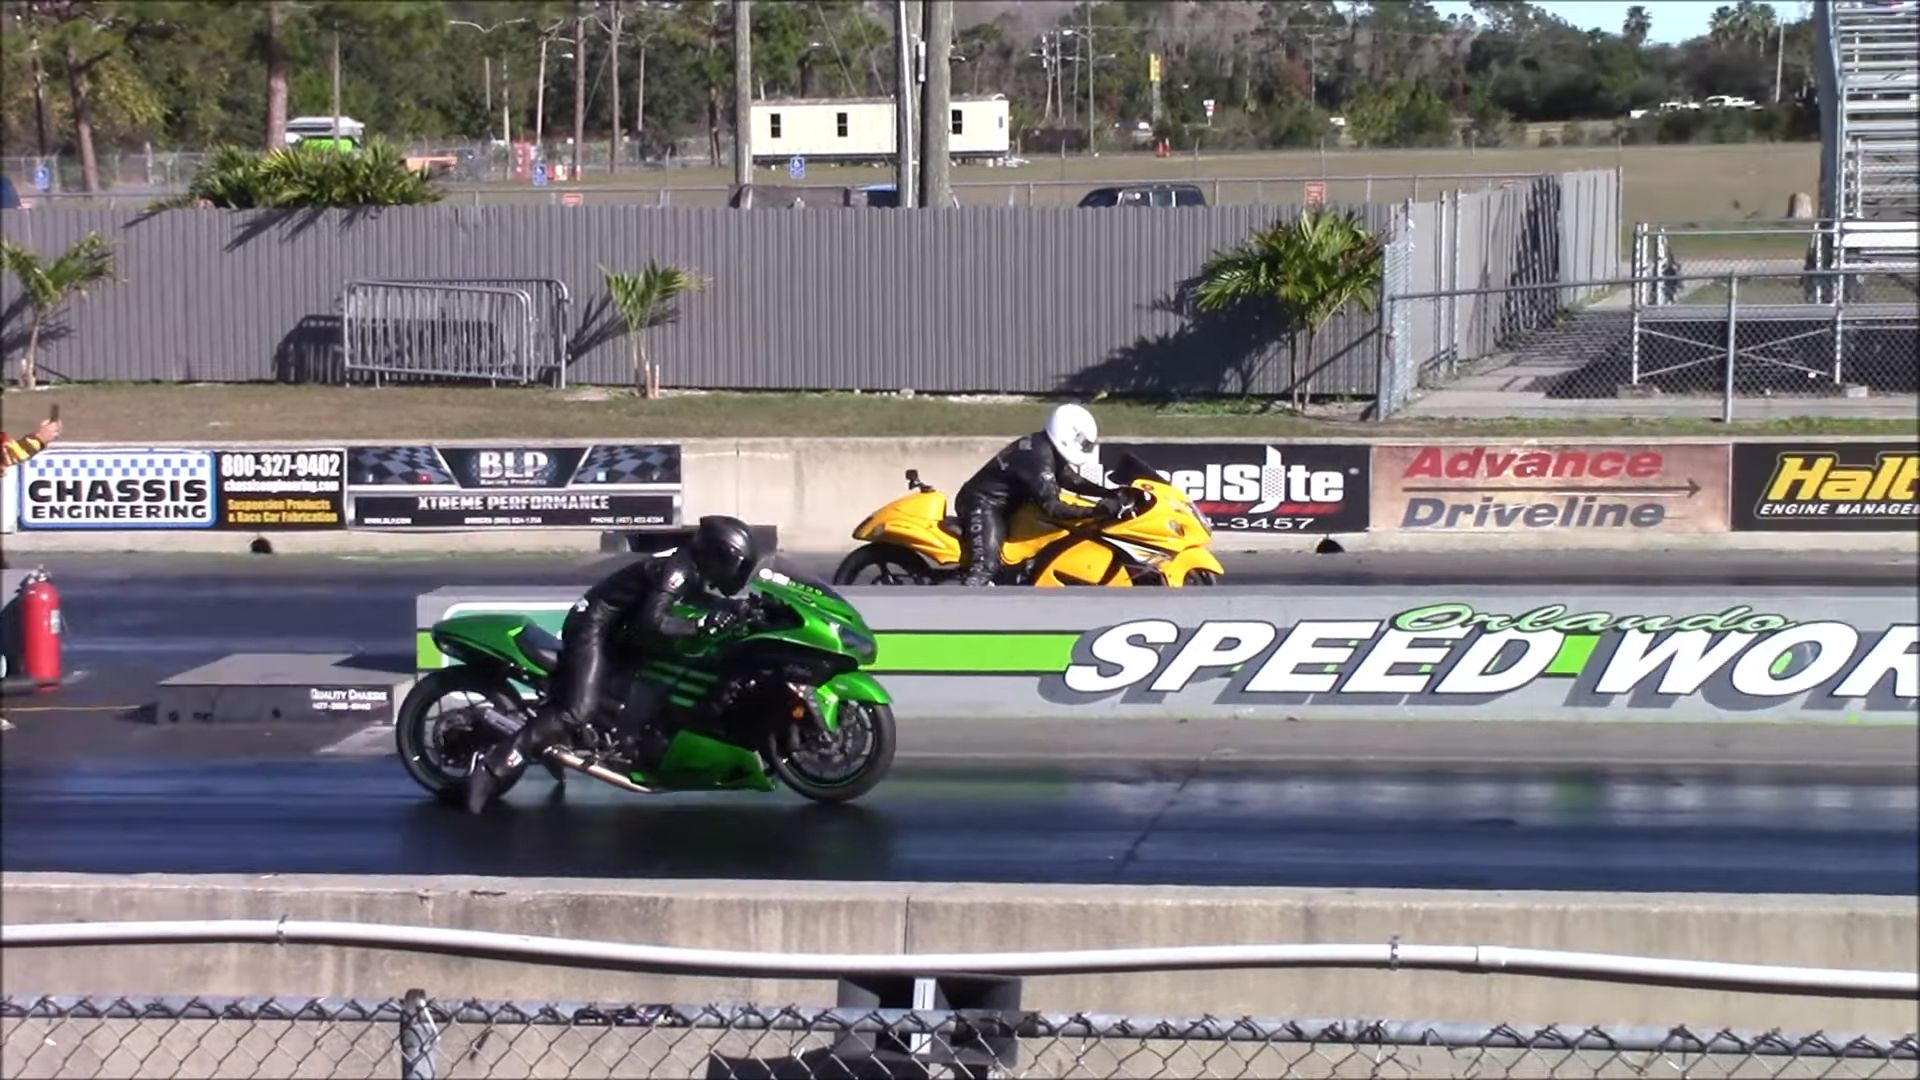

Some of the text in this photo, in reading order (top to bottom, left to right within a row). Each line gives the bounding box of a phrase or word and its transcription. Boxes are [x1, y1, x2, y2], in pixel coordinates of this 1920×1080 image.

[222, 454, 340, 477] 800-327-9402
[480, 451, 548, 478] BLP
[1402, 447, 1664, 479] Advance
[28, 479, 208, 503] CHASSIS
[418, 495, 610, 510] XTREME PERFORMANCE
[31, 505, 207, 519] ENGINEERING
[228, 499, 330, 511] Suspension Products
[237, 511, 261, 522] Race
[263, 511, 280, 522] Car
[282, 511, 338, 522] Fabrication
[1401, 496, 1666, 529] Driveline
[1759, 504, 1829, 515] ENGINE
[1391, 603, 1797, 634] Orlando
[1064, 619, 1564, 693] SPEED
